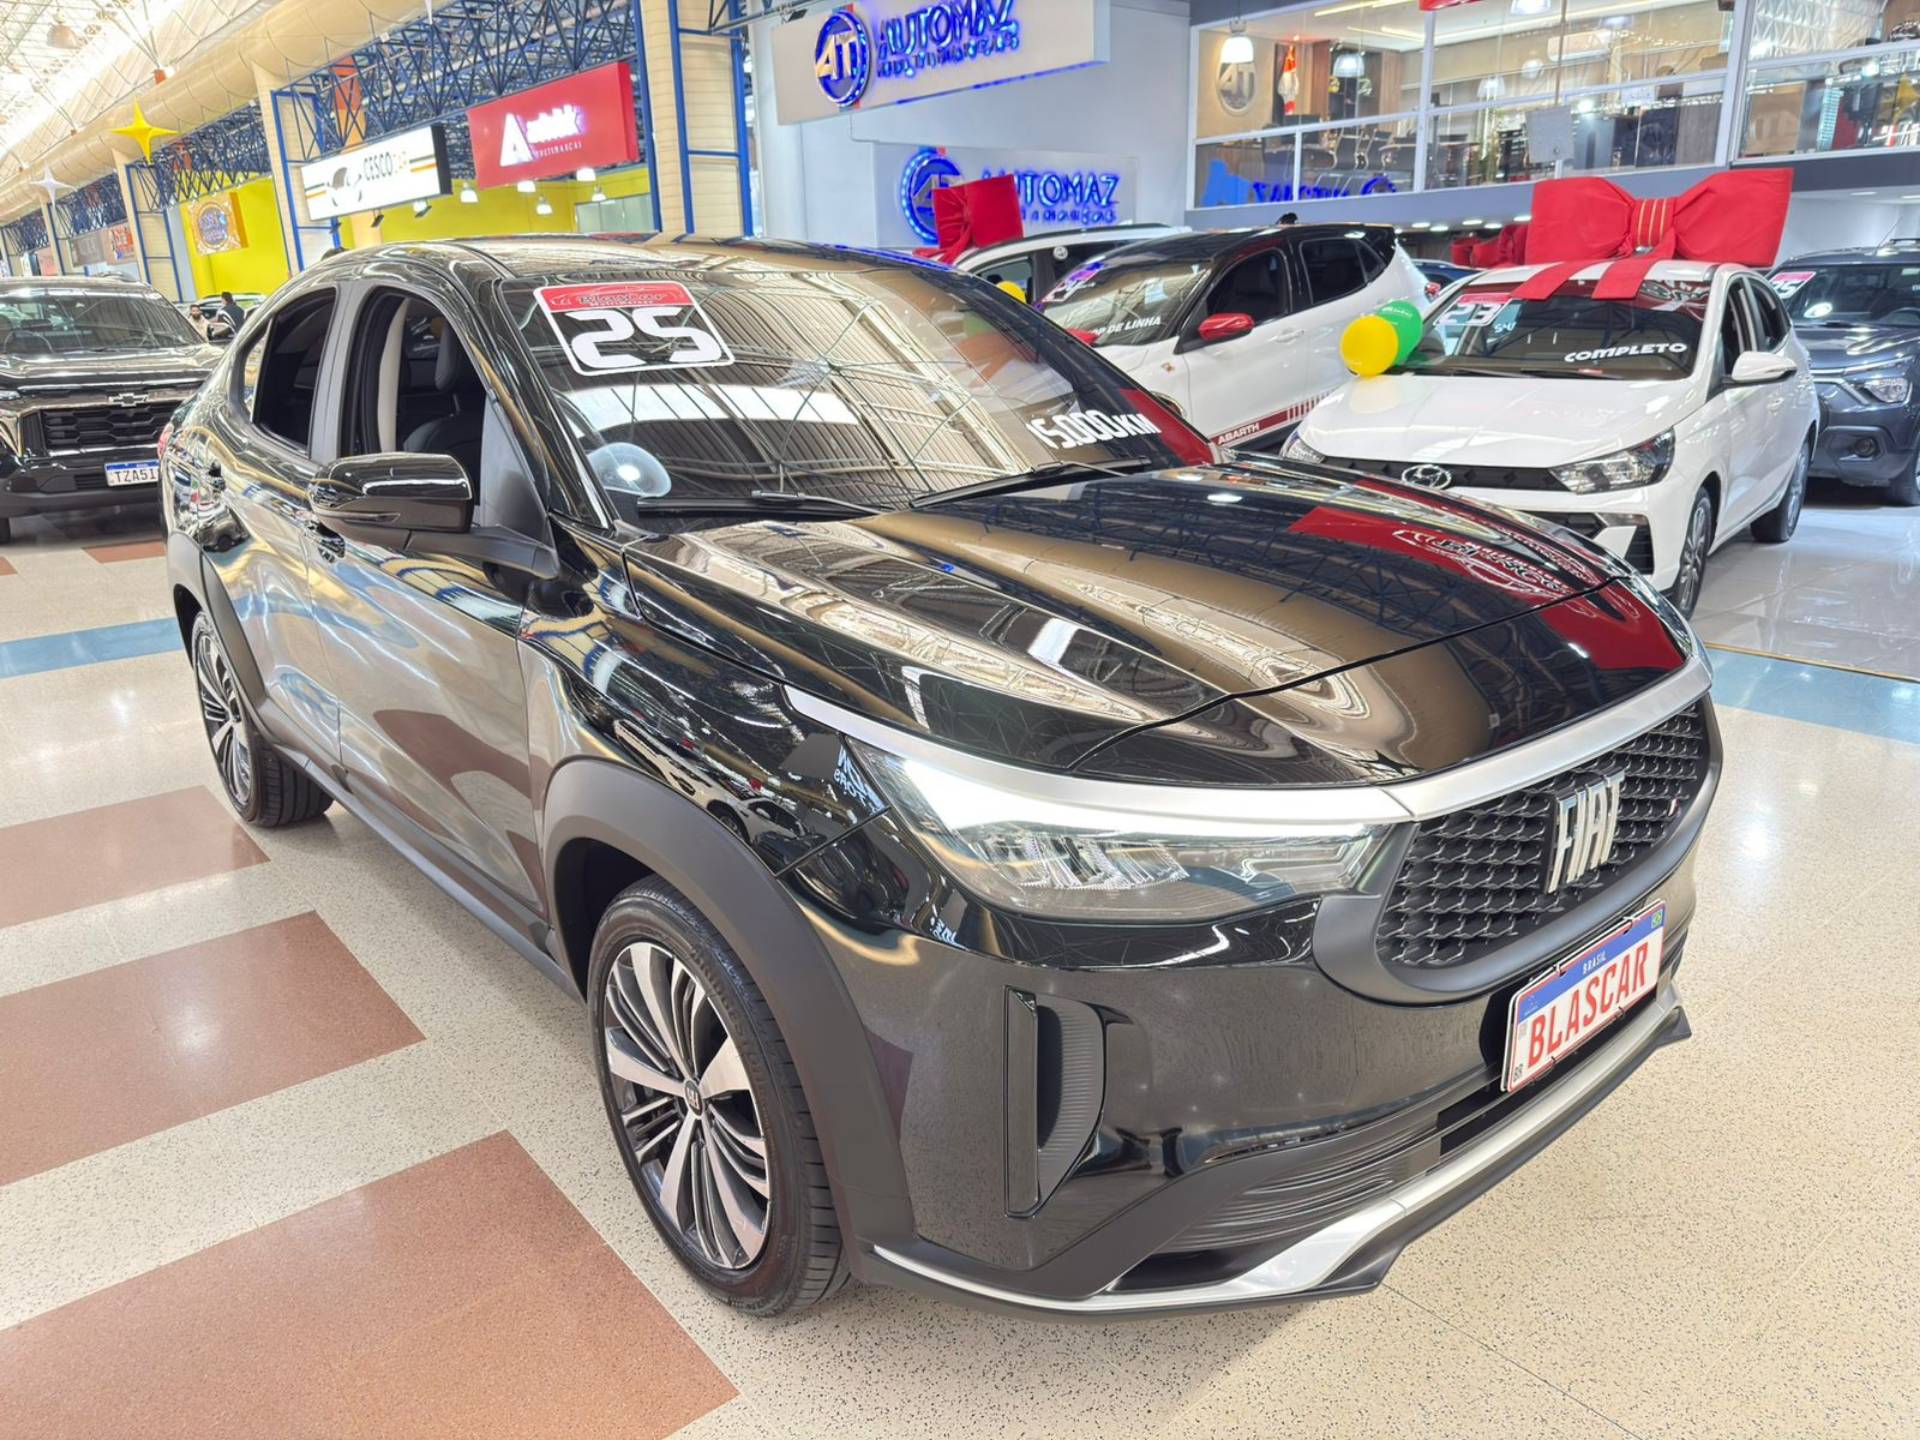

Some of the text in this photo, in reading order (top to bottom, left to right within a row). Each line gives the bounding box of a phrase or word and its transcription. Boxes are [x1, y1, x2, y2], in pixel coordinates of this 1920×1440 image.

[363, 151, 394, 181] CESCO
[1107, 323, 1125, 334] DE
[1125, 315, 1161, 331] LINHA
[1438, 303, 1503, 324] 23
[564, 306, 722, 369] 25
[1564, 342, 1688, 363] COMPLETO
[1217, 422, 1260, 445] ABARTH
[1547, 769, 1626, 895] FIAT
[1527, 941, 1649, 1069] BLASCAR
